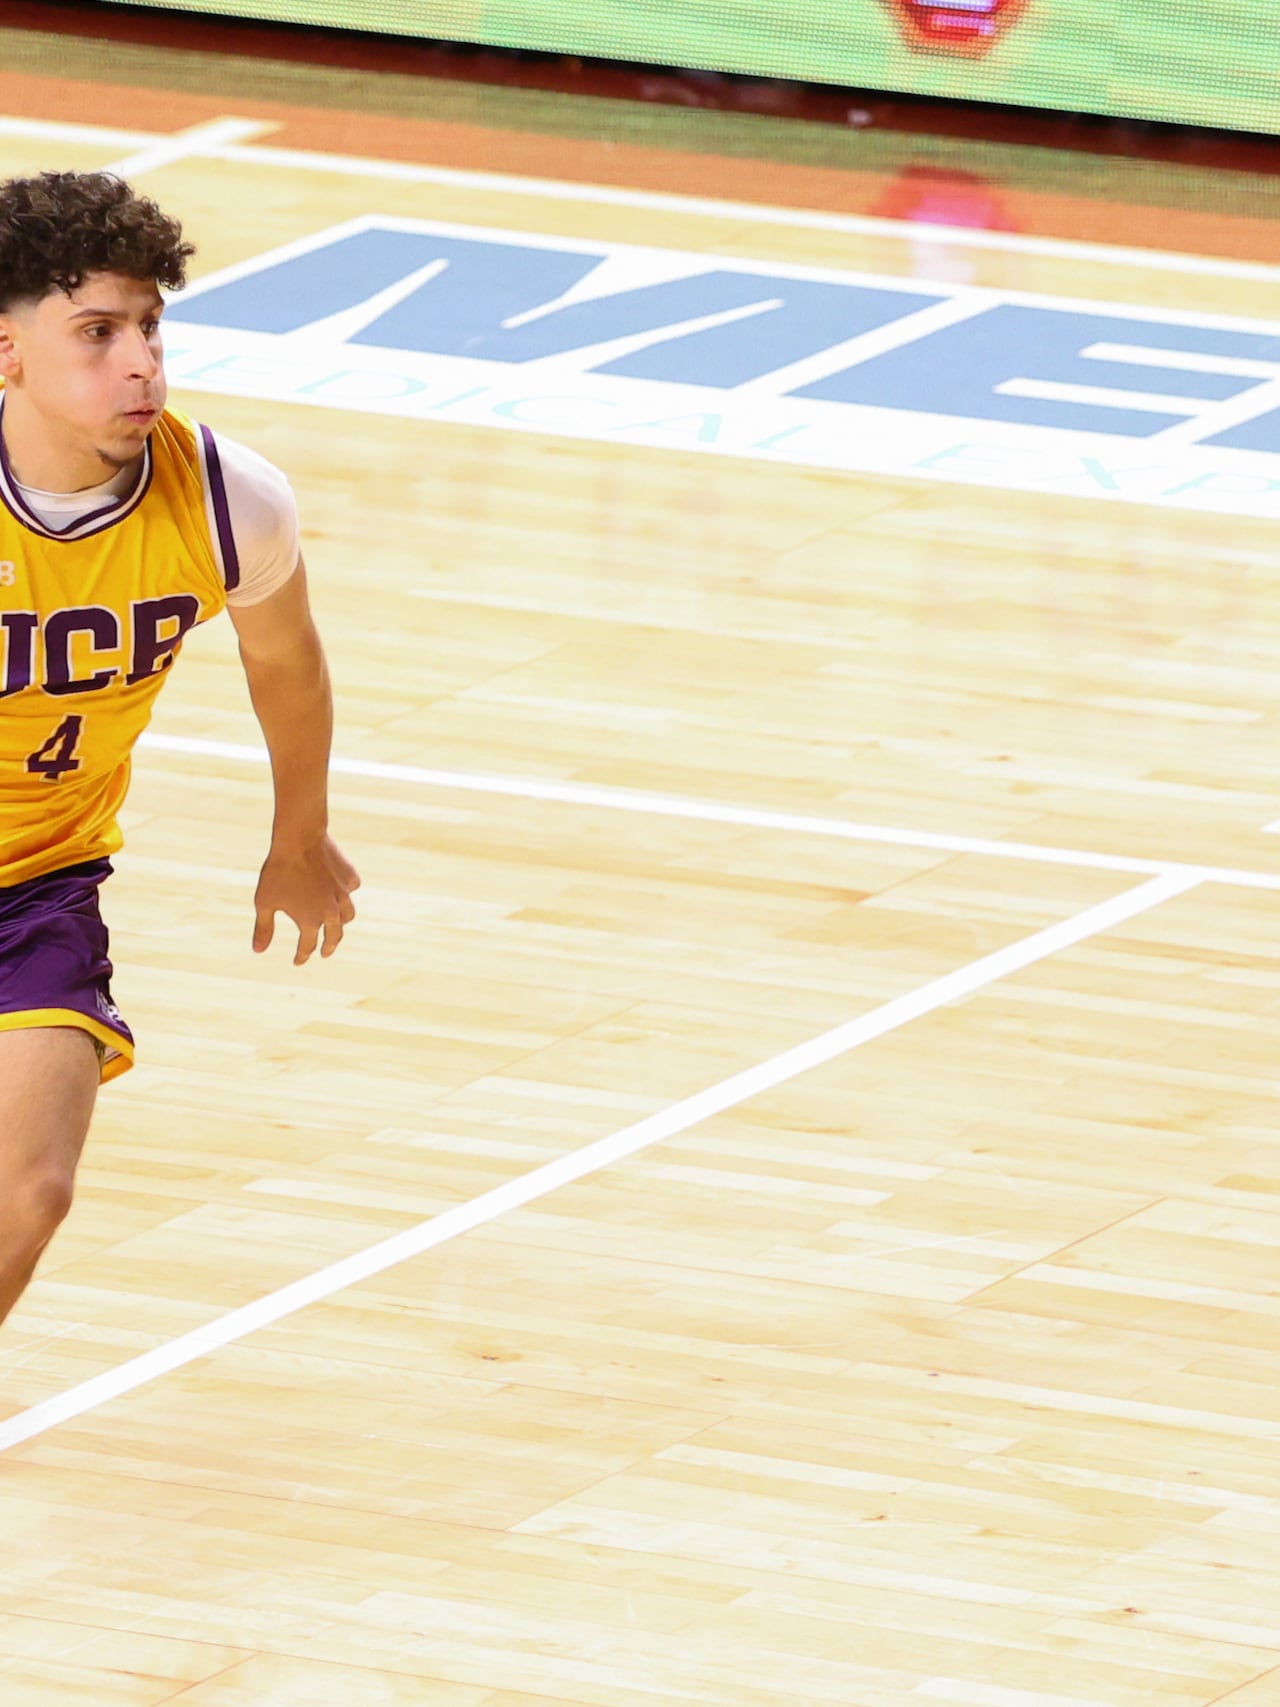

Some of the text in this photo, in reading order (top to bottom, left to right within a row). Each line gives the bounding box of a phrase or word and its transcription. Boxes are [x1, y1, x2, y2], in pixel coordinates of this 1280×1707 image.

[160, 228, 1280, 455] ME
[164, 348, 824, 456] EDICAL
[23, 711, 87, 784] 4
